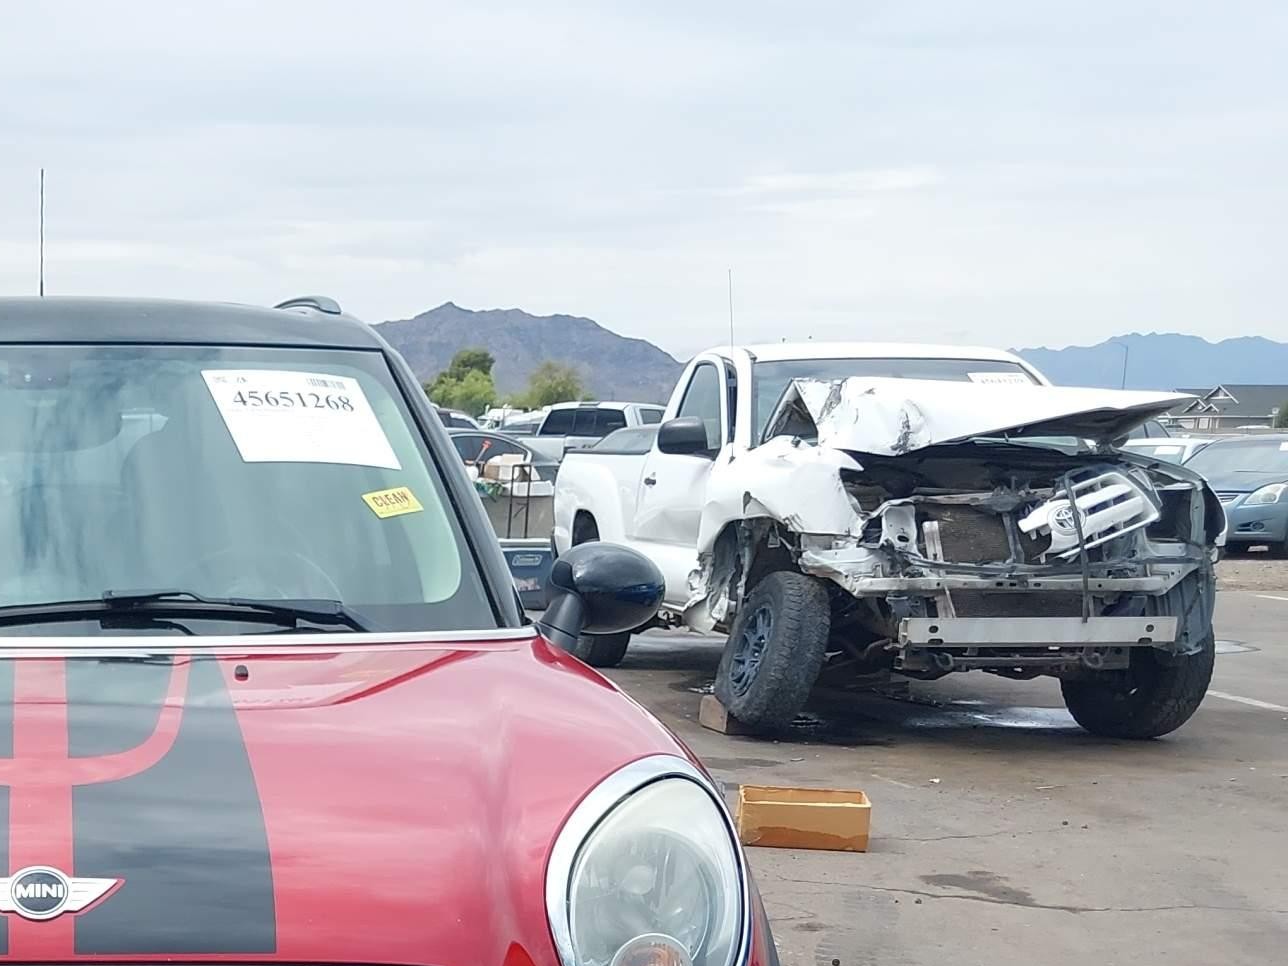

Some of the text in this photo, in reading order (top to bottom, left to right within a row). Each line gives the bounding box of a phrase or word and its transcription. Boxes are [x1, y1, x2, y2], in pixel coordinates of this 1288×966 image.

[232, 390, 355, 412] 45651268
[372, 491, 409, 507] CLEAN
[15, 883, 64, 898] MINI
